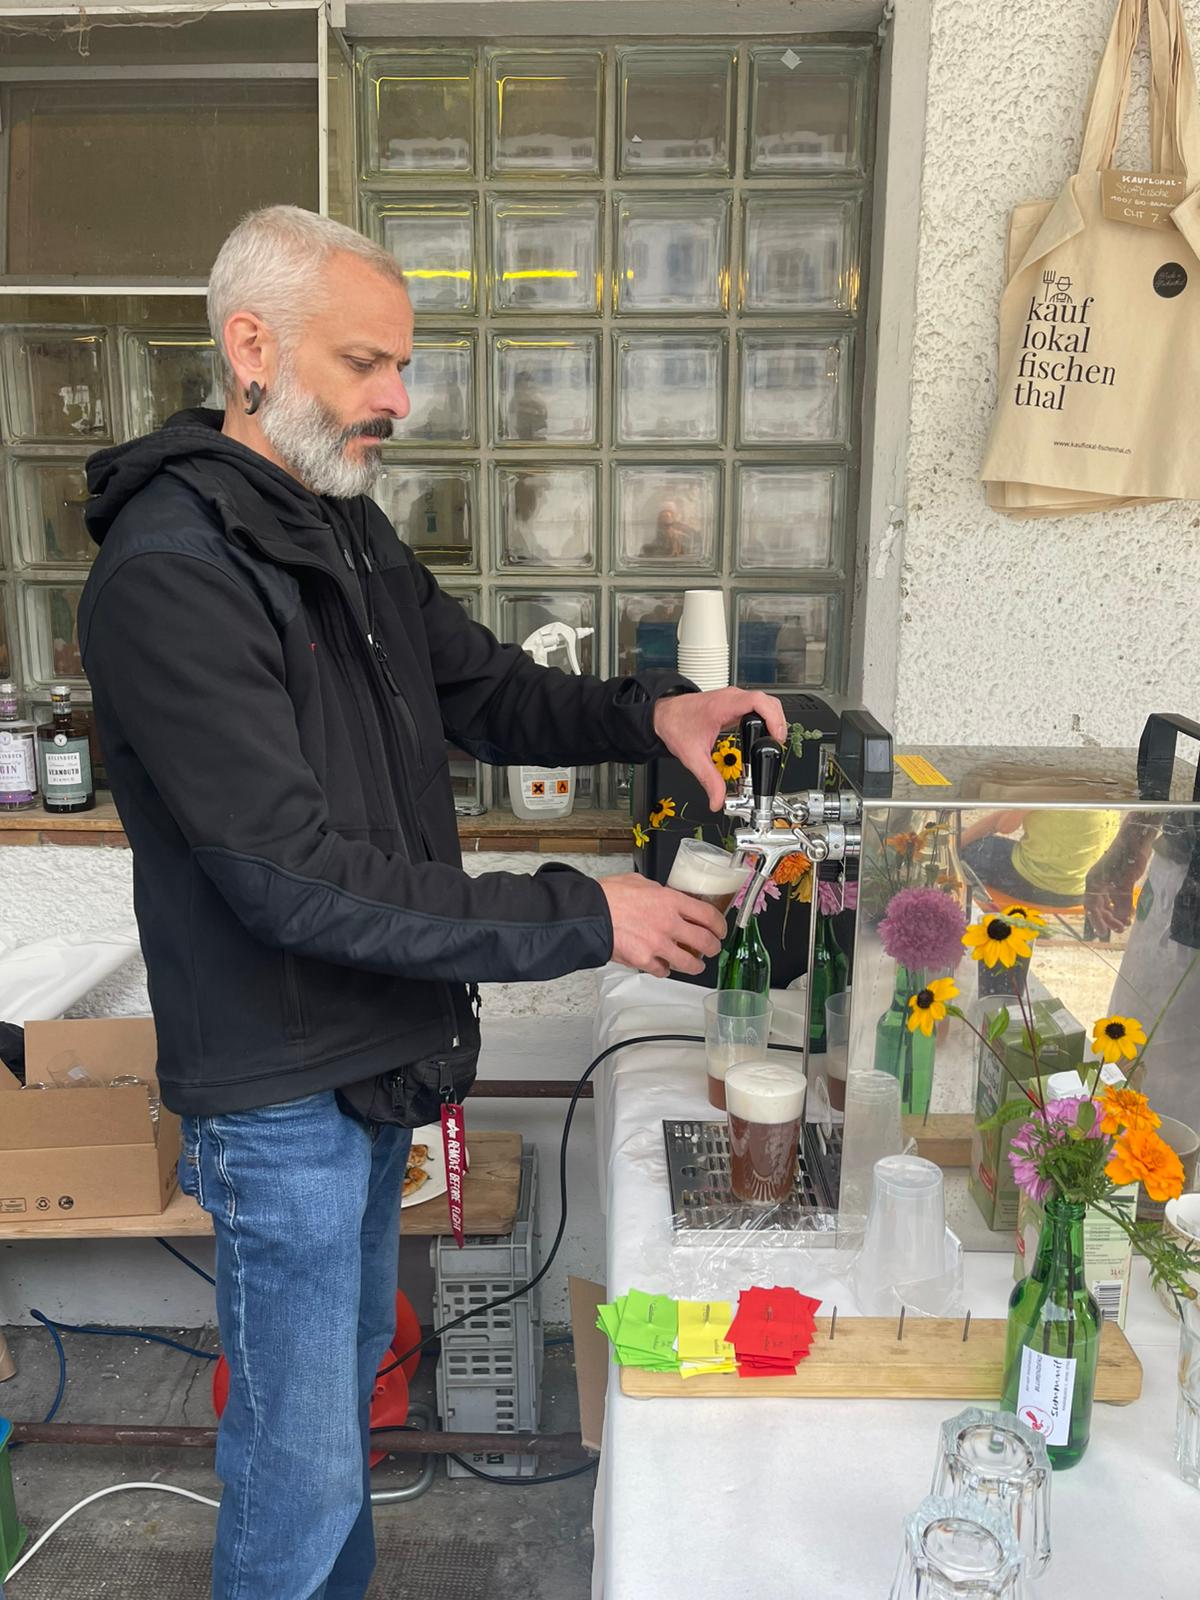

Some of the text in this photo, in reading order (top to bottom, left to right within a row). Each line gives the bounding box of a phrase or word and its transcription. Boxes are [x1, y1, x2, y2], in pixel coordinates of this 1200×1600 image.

[1027, 296, 1095, 324] kauf
[1021, 324, 1091, 353] lokal
[1016, 352, 1116, 386] fischen
[1014, 381, 1066, 411] thal
[448, 1139, 462, 1232] REMOVE BEFORE FLIGHT
